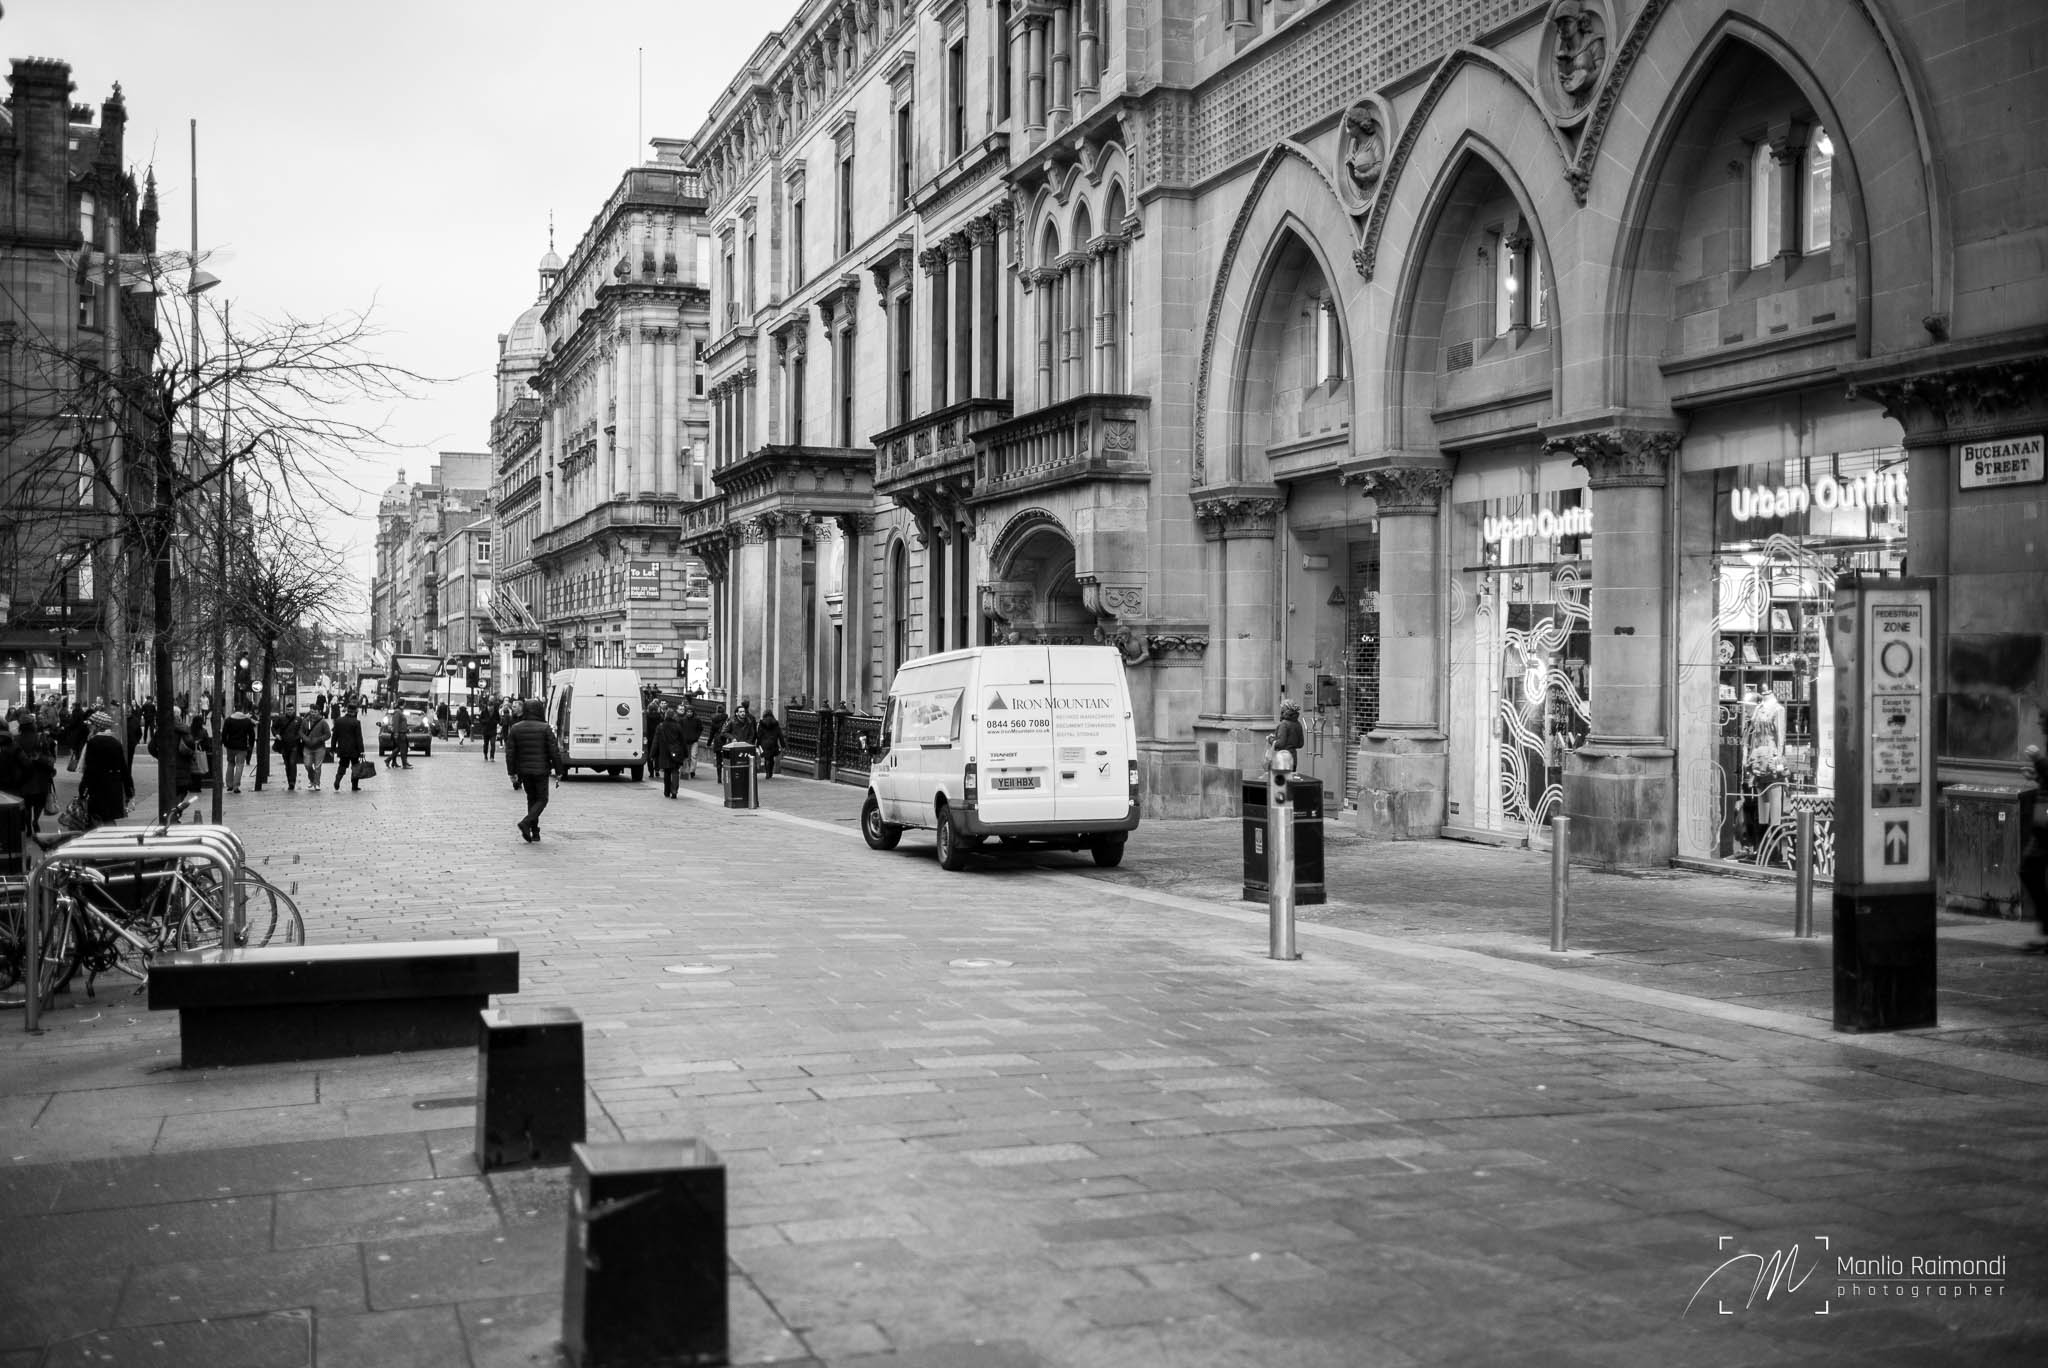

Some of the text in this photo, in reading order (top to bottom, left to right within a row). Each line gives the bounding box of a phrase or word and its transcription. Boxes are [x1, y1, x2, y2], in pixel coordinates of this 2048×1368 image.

[1965, 440, 2040, 461] BUCHANAN
[1975, 458, 2029, 476] STREET
[1731, 483, 1810, 522] Urban
[1483, 514, 1537, 543] Urban
[630, 568, 656, 577] To Let
[1875, 610, 1919, 618] PEDESTRIAN
[1883, 622, 1911, 632] ZONE
[1012, 697, 1111, 710] IRON MOUNTAIN
[986, 719, 1050, 728] 0844 560 7080
[1016, 777, 1034, 787] HBX
